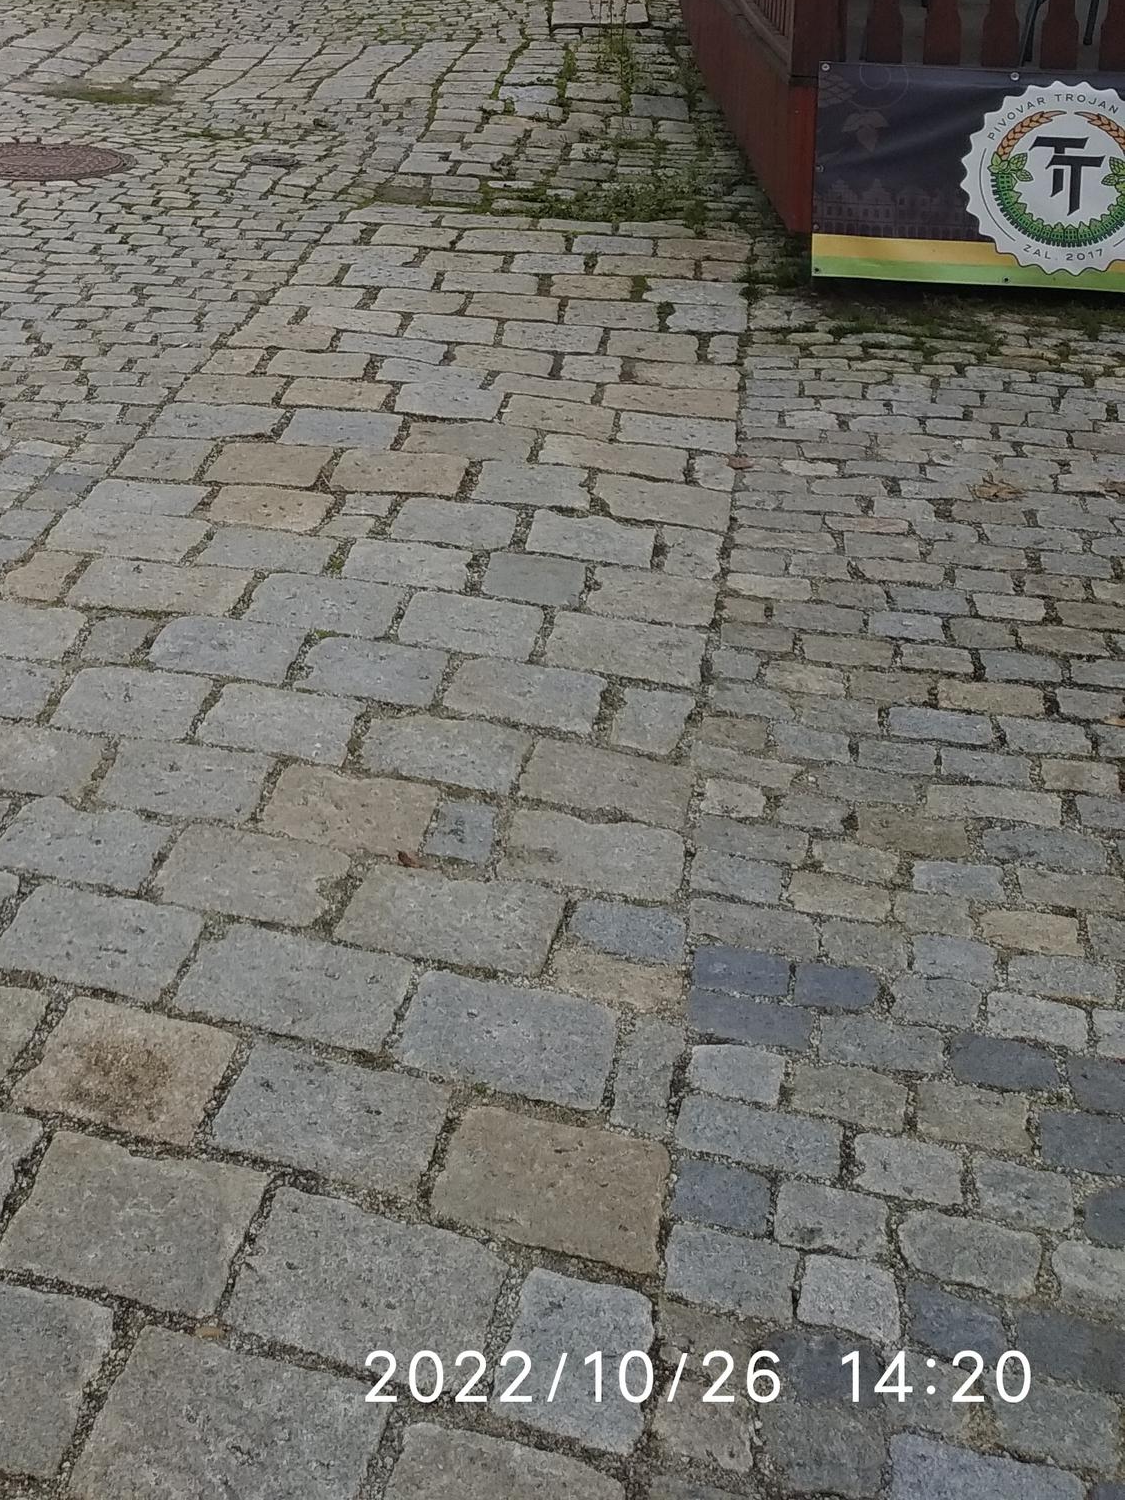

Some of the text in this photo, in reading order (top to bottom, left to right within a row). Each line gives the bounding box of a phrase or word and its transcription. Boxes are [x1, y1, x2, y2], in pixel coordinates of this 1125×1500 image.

[987, 93, 1119, 141] PIVOVAR TROJAN
[1066, 248, 1103, 261] 2017
